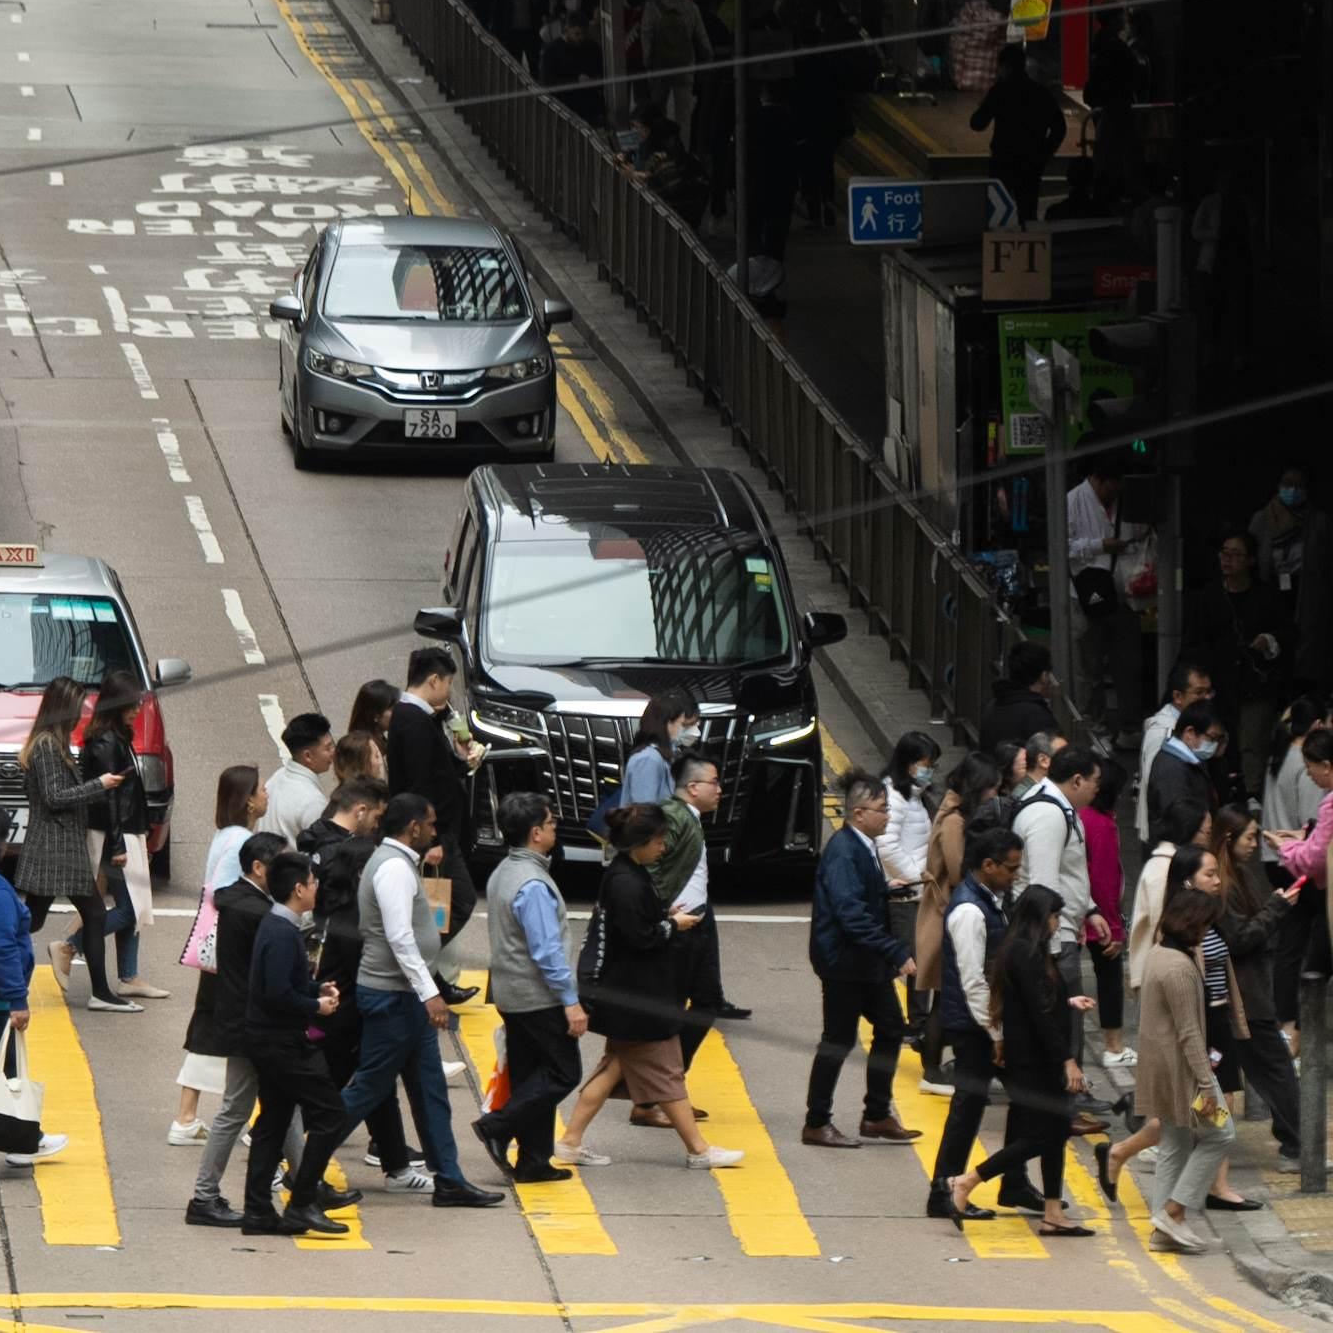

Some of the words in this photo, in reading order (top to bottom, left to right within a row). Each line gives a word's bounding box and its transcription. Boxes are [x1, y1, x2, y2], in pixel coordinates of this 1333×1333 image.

[990, 240, 1046, 274] FT
[420, 409, 441, 424] SA
[409, 423, 452, 438] 7220
